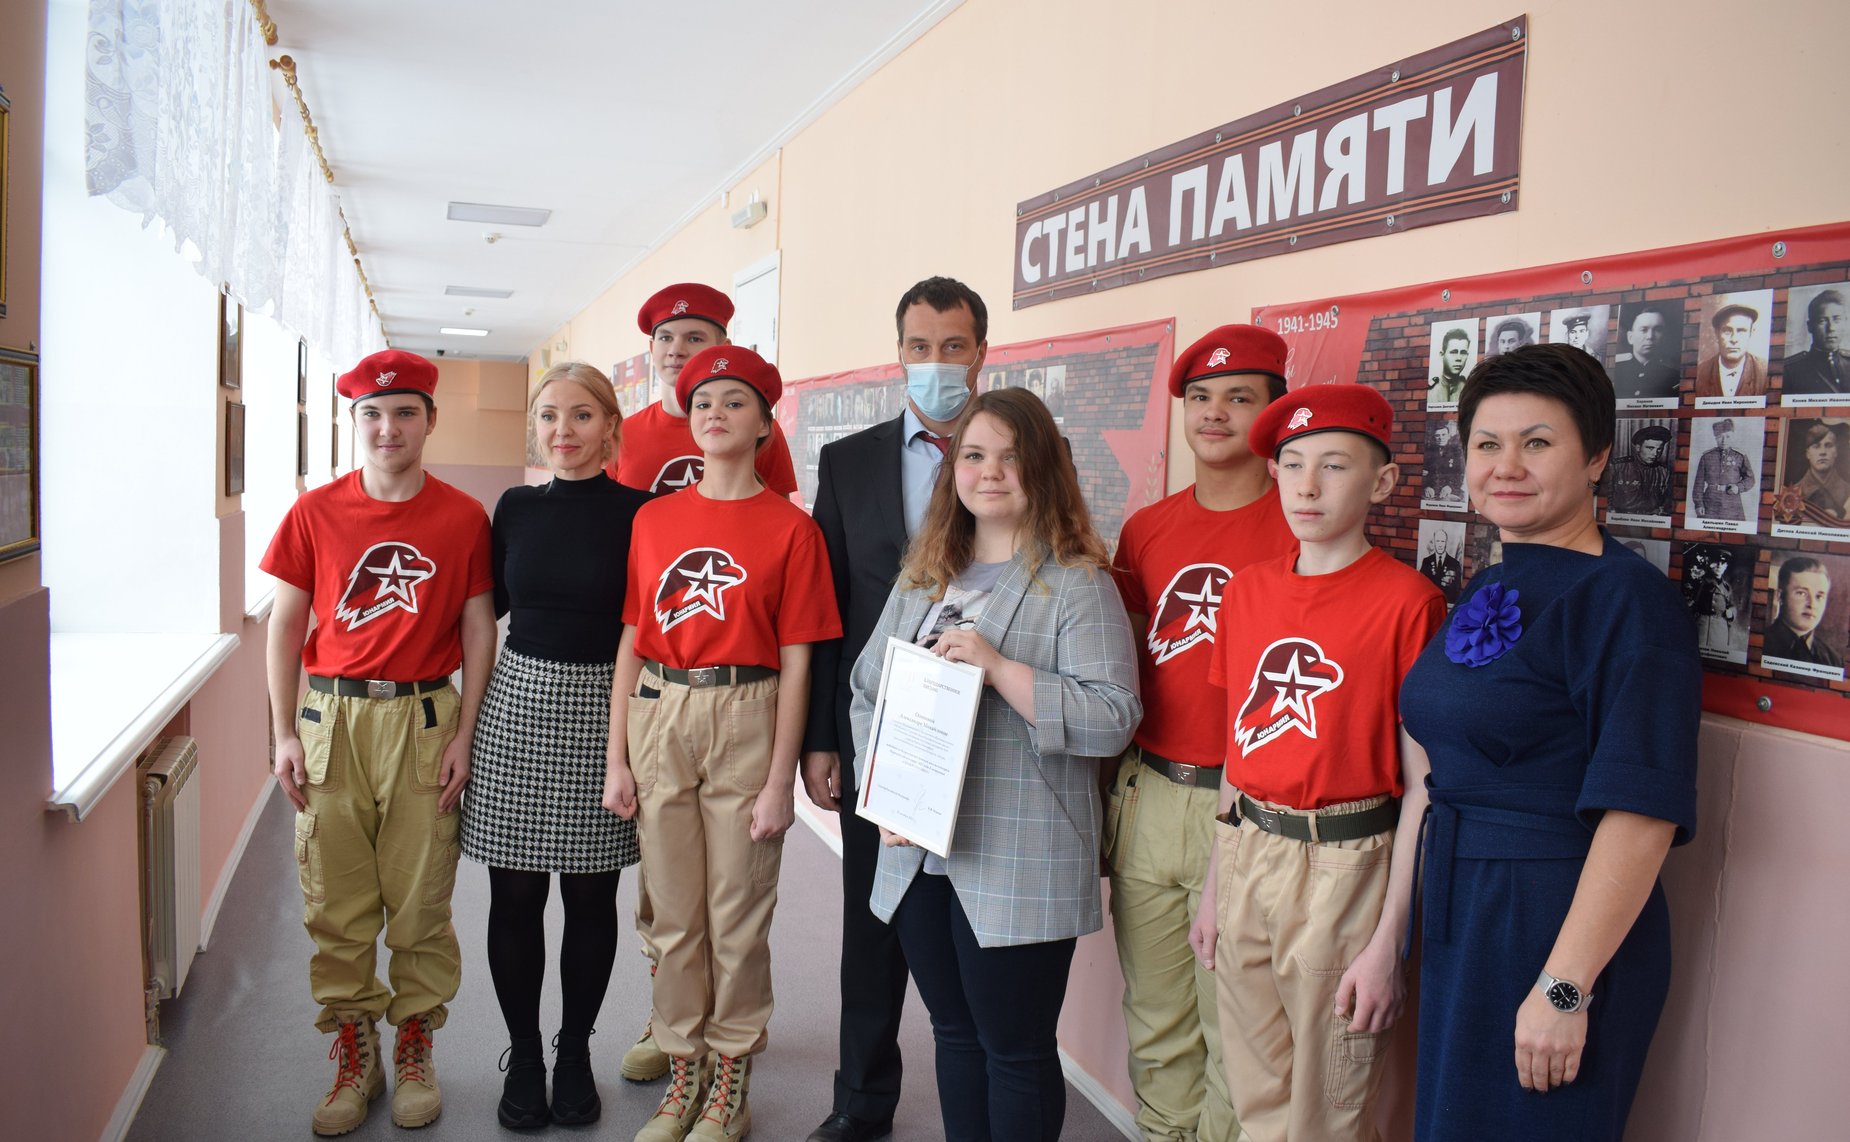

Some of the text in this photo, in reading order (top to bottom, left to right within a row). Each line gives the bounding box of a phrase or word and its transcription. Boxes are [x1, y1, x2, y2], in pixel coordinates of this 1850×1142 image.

[1020, 71, 1499, 284] СТЕНА ПАМЯТИ
[1277, 311, 1339, 335] 1941-1945
[362, 596, 395, 617] ЮНАРМИЯ
[1256, 713, 1291, 740] ЮНАРМИЯ
